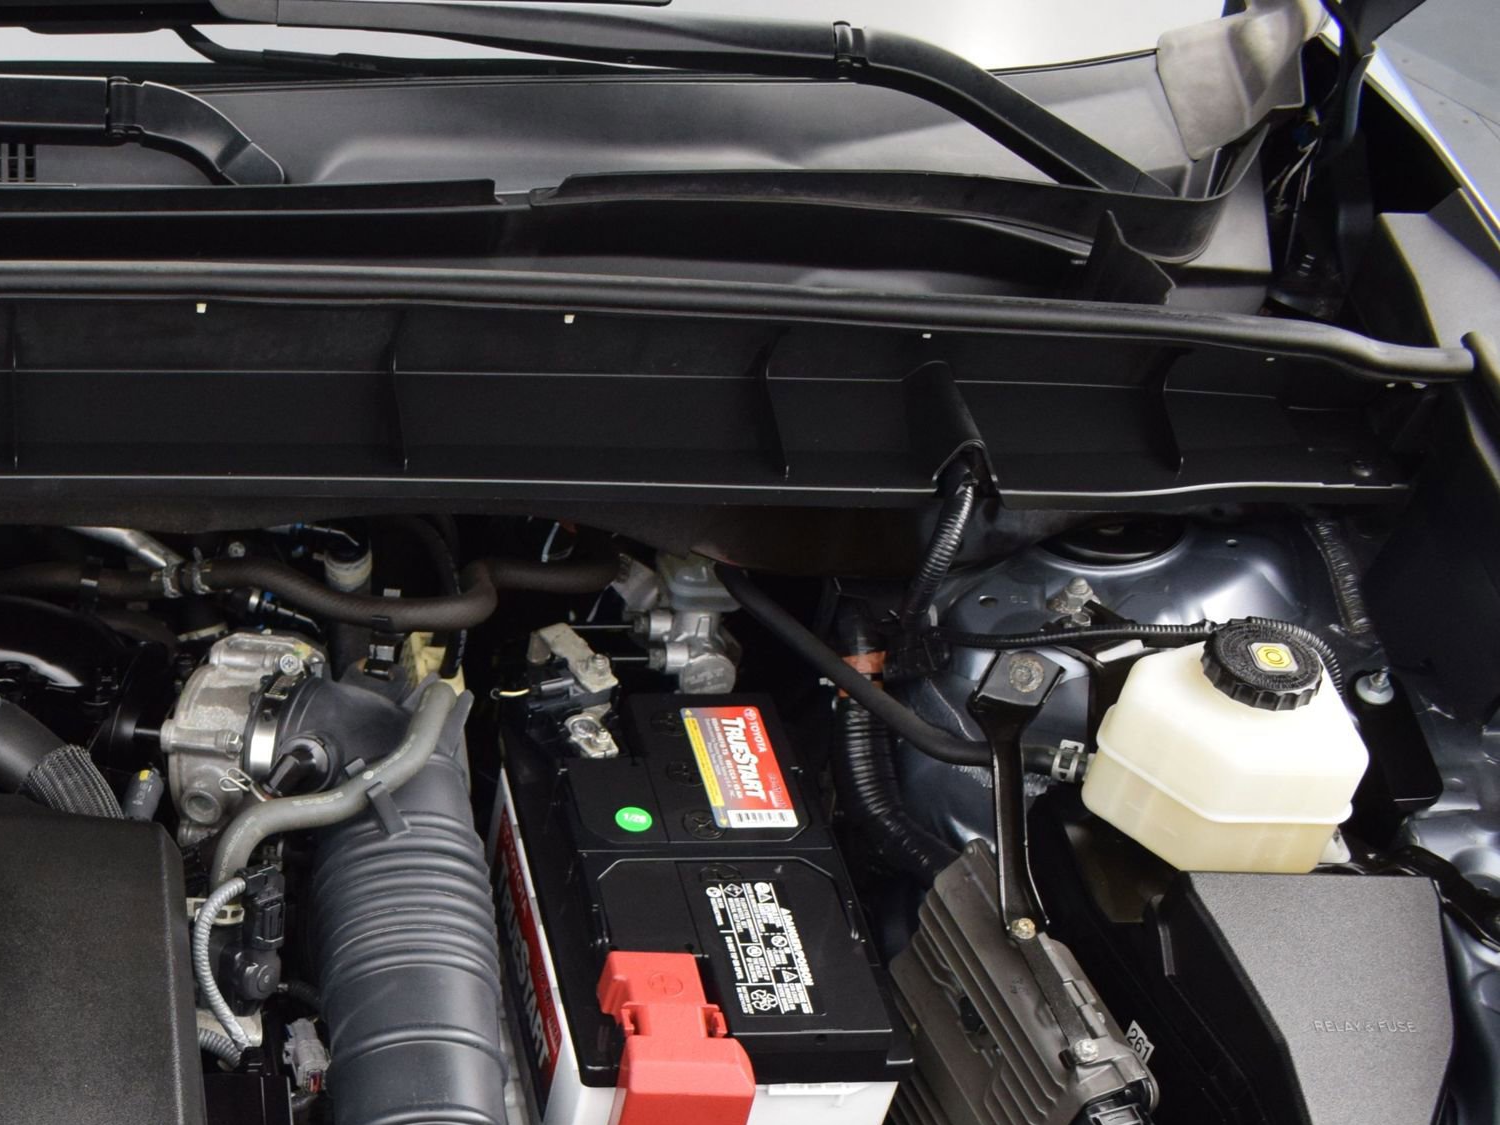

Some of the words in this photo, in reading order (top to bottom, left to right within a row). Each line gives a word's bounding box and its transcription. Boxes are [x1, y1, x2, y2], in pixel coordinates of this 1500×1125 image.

[749, 721, 768, 753] TOYOTA
[1313, 1020, 1361, 1032] RELAY
[1378, 1019, 1417, 1033] FUSE
[1126, 1027, 1151, 1060] 261
